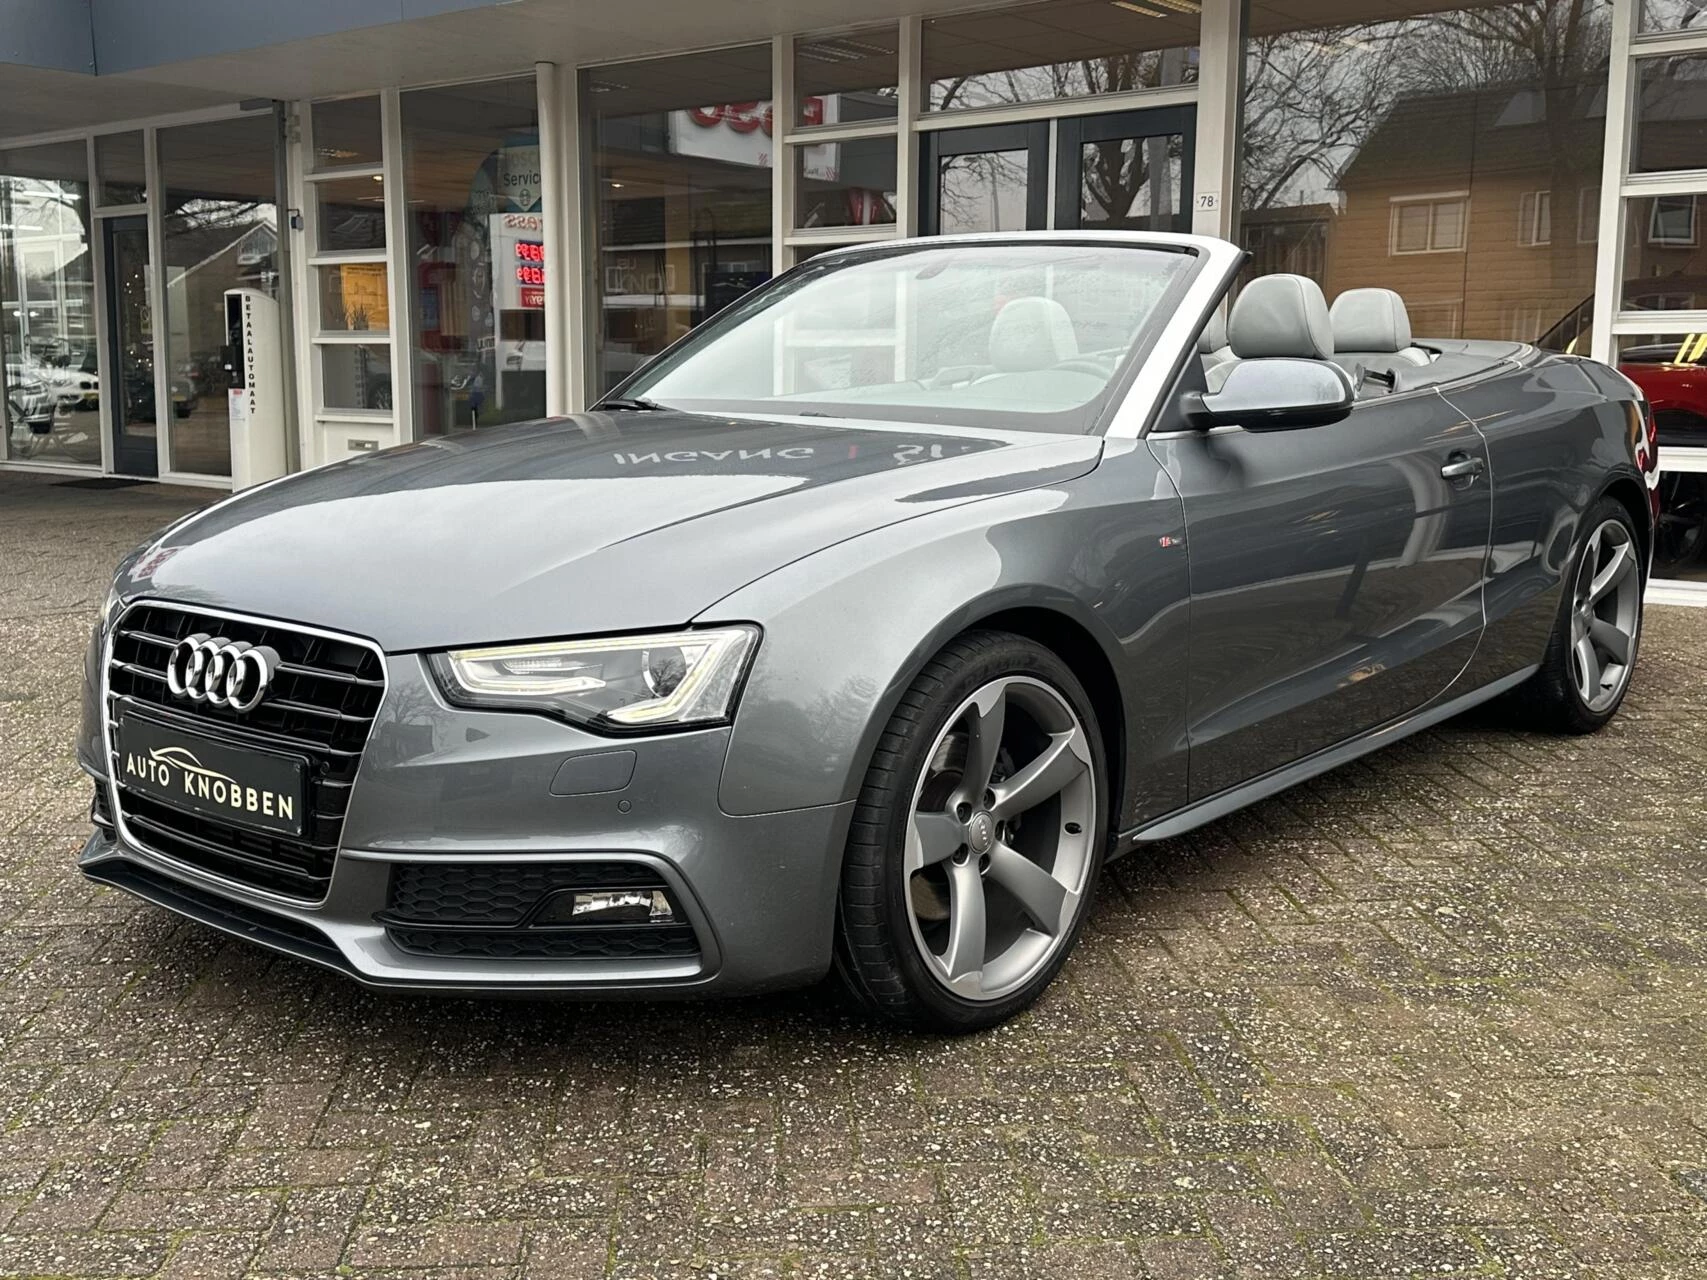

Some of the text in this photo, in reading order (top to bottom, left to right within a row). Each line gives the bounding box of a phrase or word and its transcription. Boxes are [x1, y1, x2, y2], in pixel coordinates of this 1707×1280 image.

[503, 169, 541, 187] Servic
[1200, 195, 1214, 208] 78
[245, 295, 257, 414] BETAALAUTOMAAT
[127, 752, 294, 820] AUTO KNOBBEN
